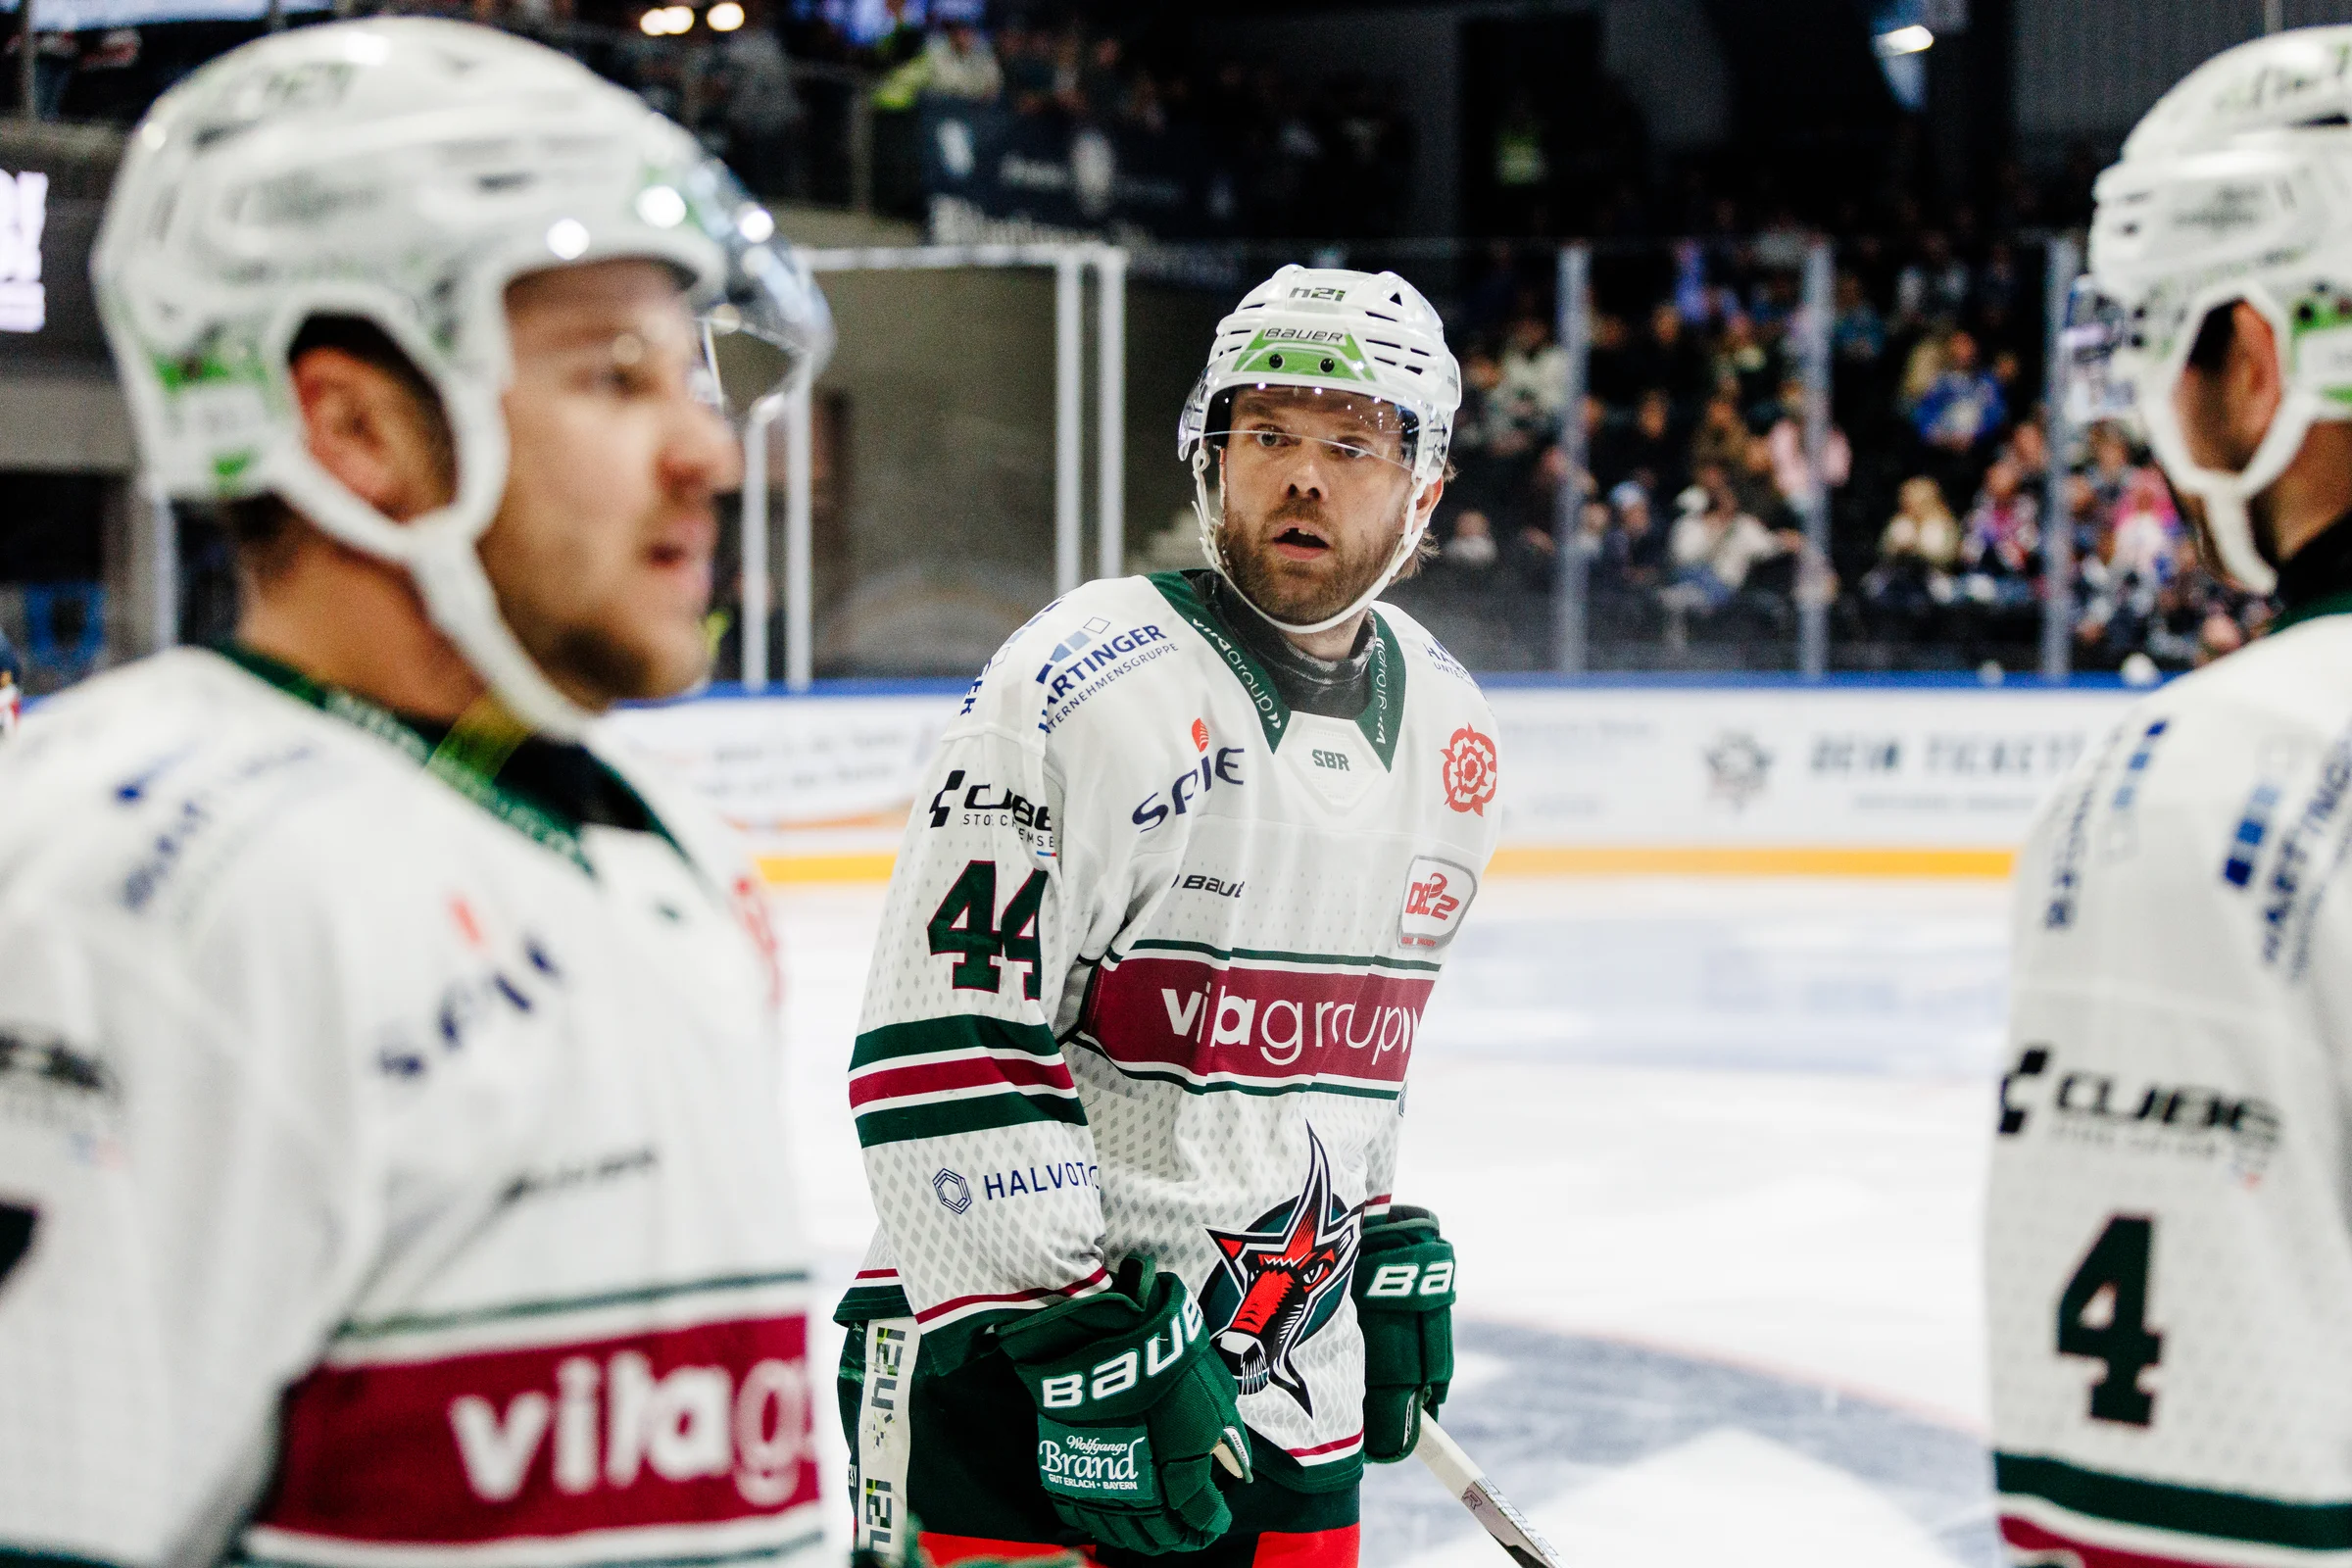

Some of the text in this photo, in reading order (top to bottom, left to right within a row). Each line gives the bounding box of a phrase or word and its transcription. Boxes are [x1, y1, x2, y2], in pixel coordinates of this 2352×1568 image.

[1312, 749, 1350, 771] SBR
[1132, 747, 1245, 833] SPIE
[927, 859, 1049, 1001] 44
[2055, 1211, 2164, 1429] 4
[1039, 1436, 1146, 1480] Brand
[1066, 1435, 1128, 1455] Wolfgangs
[1048, 1473, 1138, 1490] GUT ERLACH BAYERN
